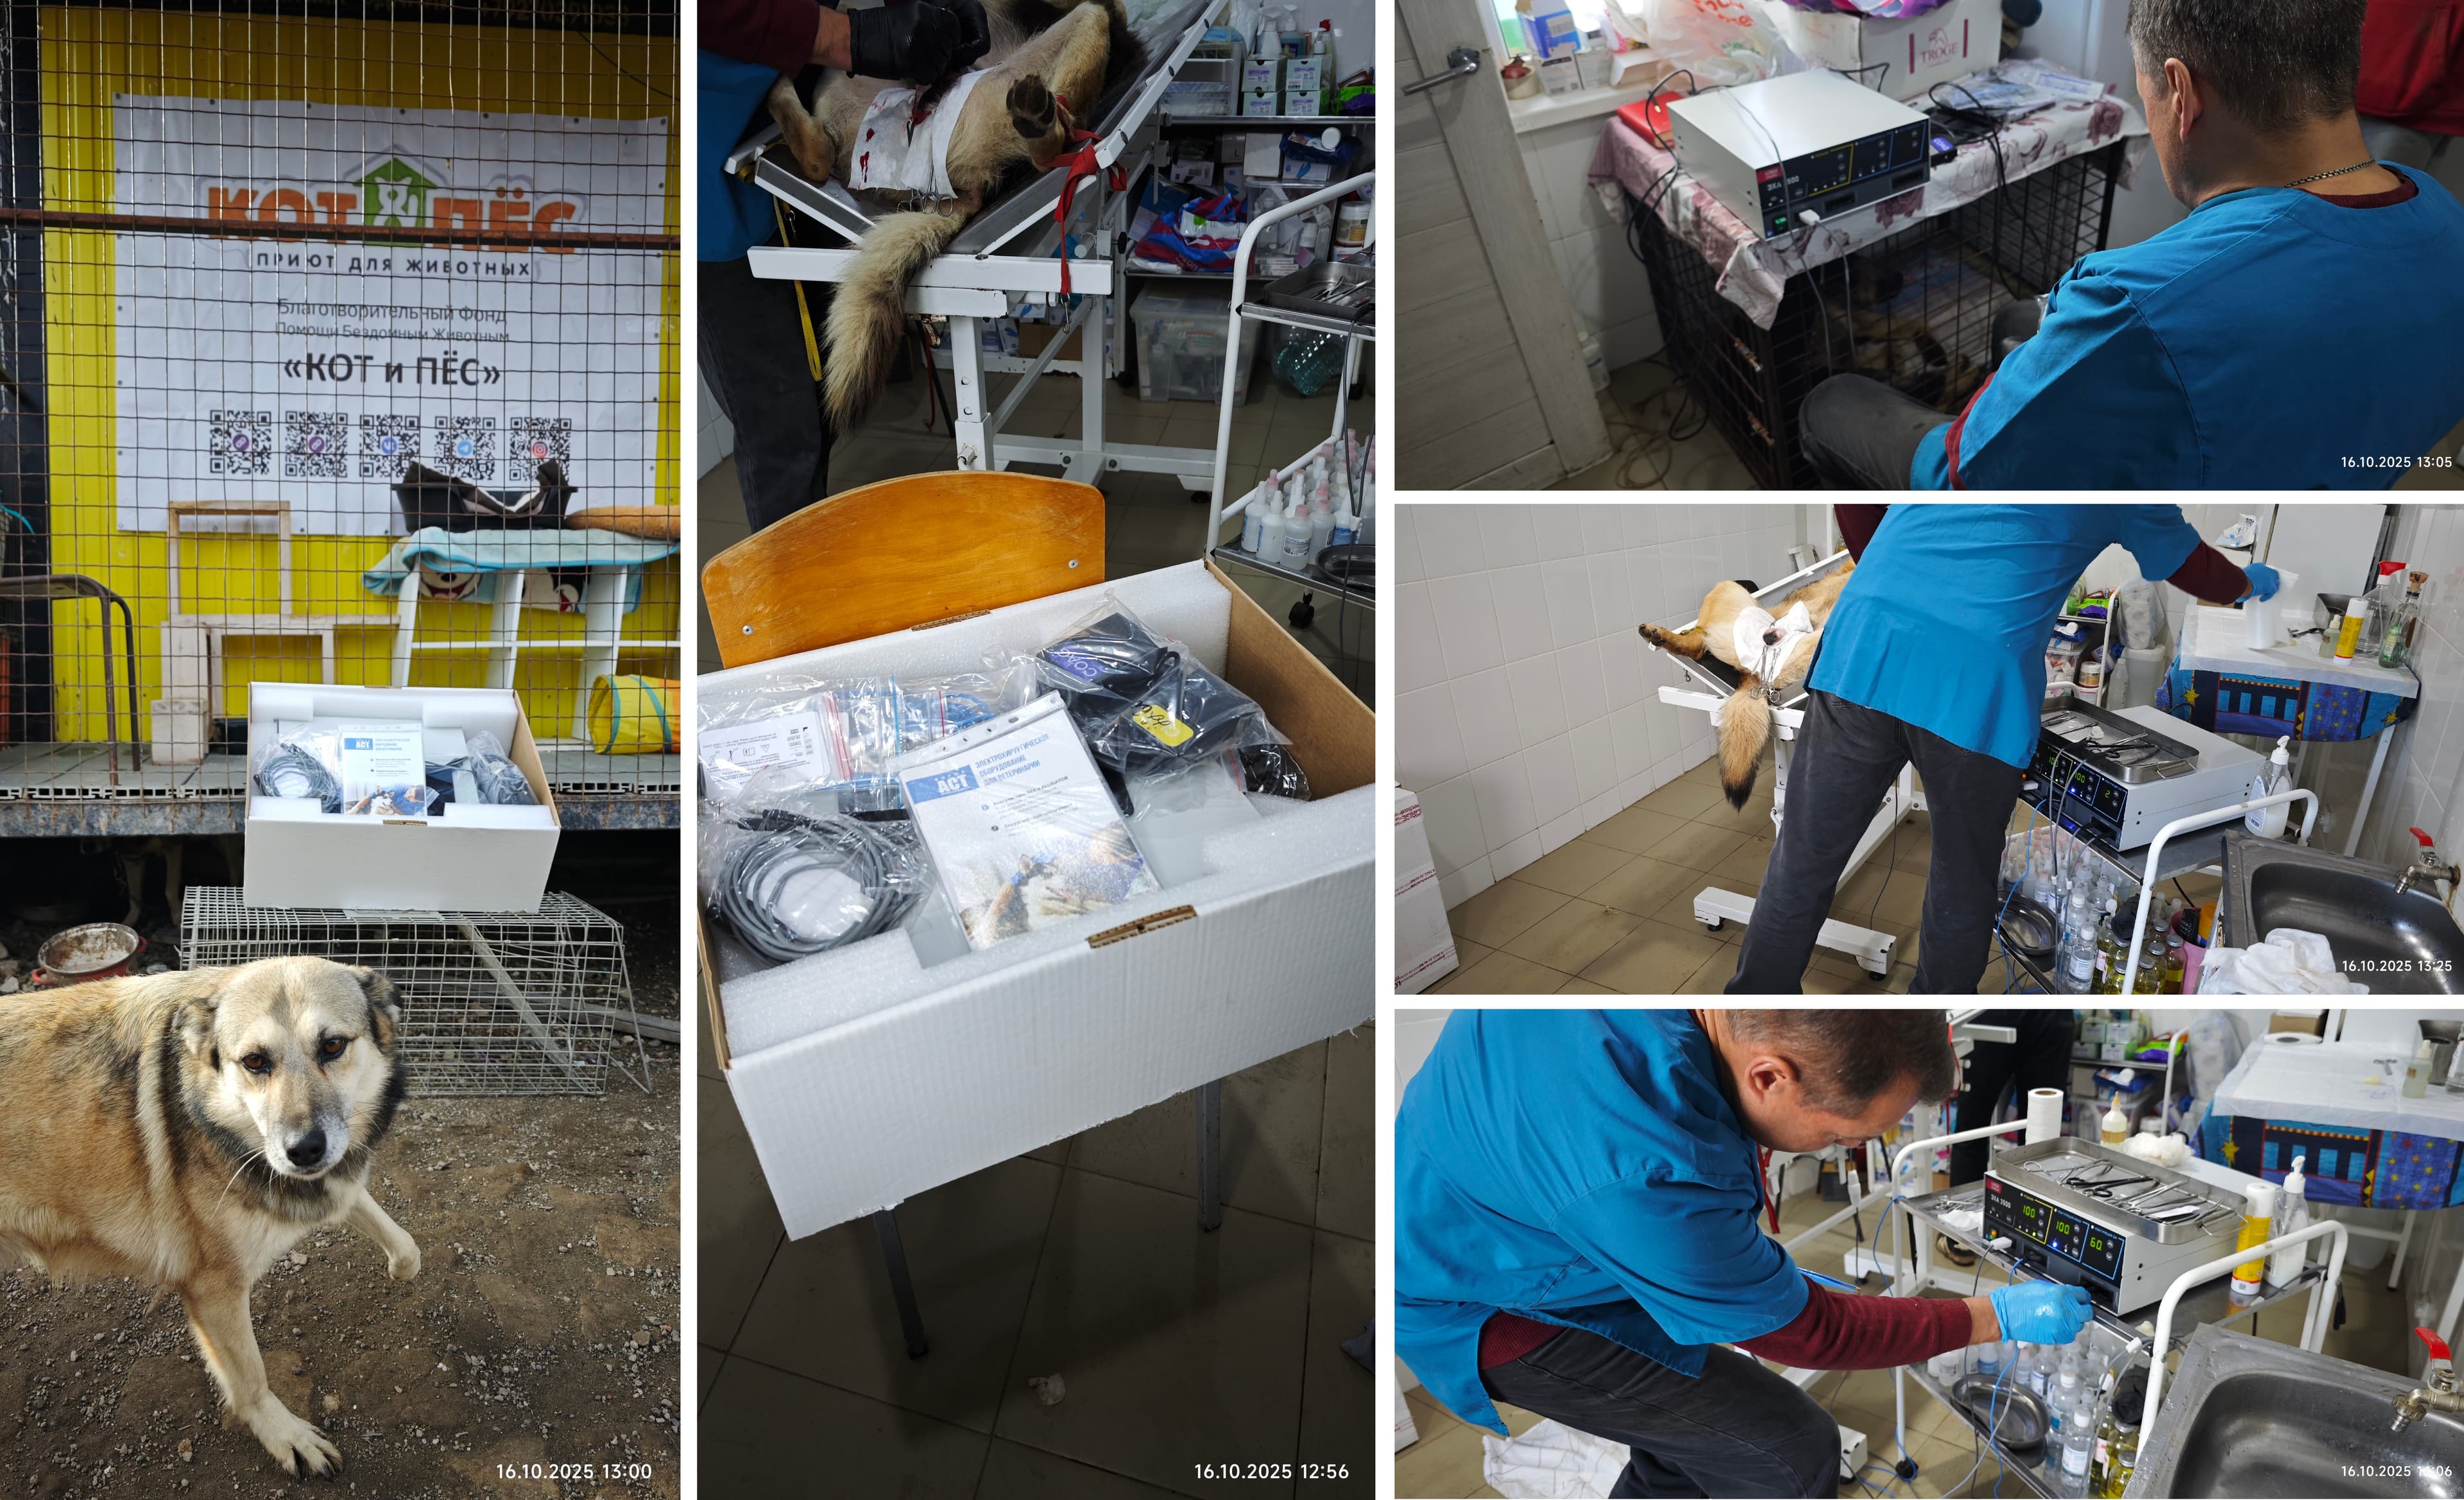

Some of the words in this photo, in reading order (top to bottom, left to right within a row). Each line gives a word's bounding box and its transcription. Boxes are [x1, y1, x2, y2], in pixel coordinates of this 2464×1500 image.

[1920, 42, 1958, 63] TROGE
[1784, 175, 1800, 185] 500
[209, 187, 357, 244] КОТ
[433, 186, 576, 255] ПЁС
[257, 253, 334, 268] ПРИЮТ
[349, 257, 391, 273] ДЛЯ
[406, 259, 529, 276] ЖИВОТНЫХ
[278, 298, 454, 321] Благотворительный
[459, 305, 506, 325] Фонд
[275, 321, 338, 339] Помощи
[343, 325, 428, 341] Бездомным
[432, 328, 509, 343] Животным
[284, 352, 373, 383] «КОТ
[385, 362, 402, 384] и
[416, 350, 501, 386] ПЁС»
[1059, 647, 1097, 677] COAG
[975, 733, 1052, 769] ЭЛЕКТРОХИРУРГИЧЕСКОЕ
[979, 754, 1028, 778] ОБОРУДОВАНИЕ
[998, 759, 1041, 781] ВЕТЕРИНАРИИ
[2000, 1198, 2011, 1209] 3500
[2023, 1205, 2036, 1218] 100
[2056, 1221, 2070, 1235] 100
